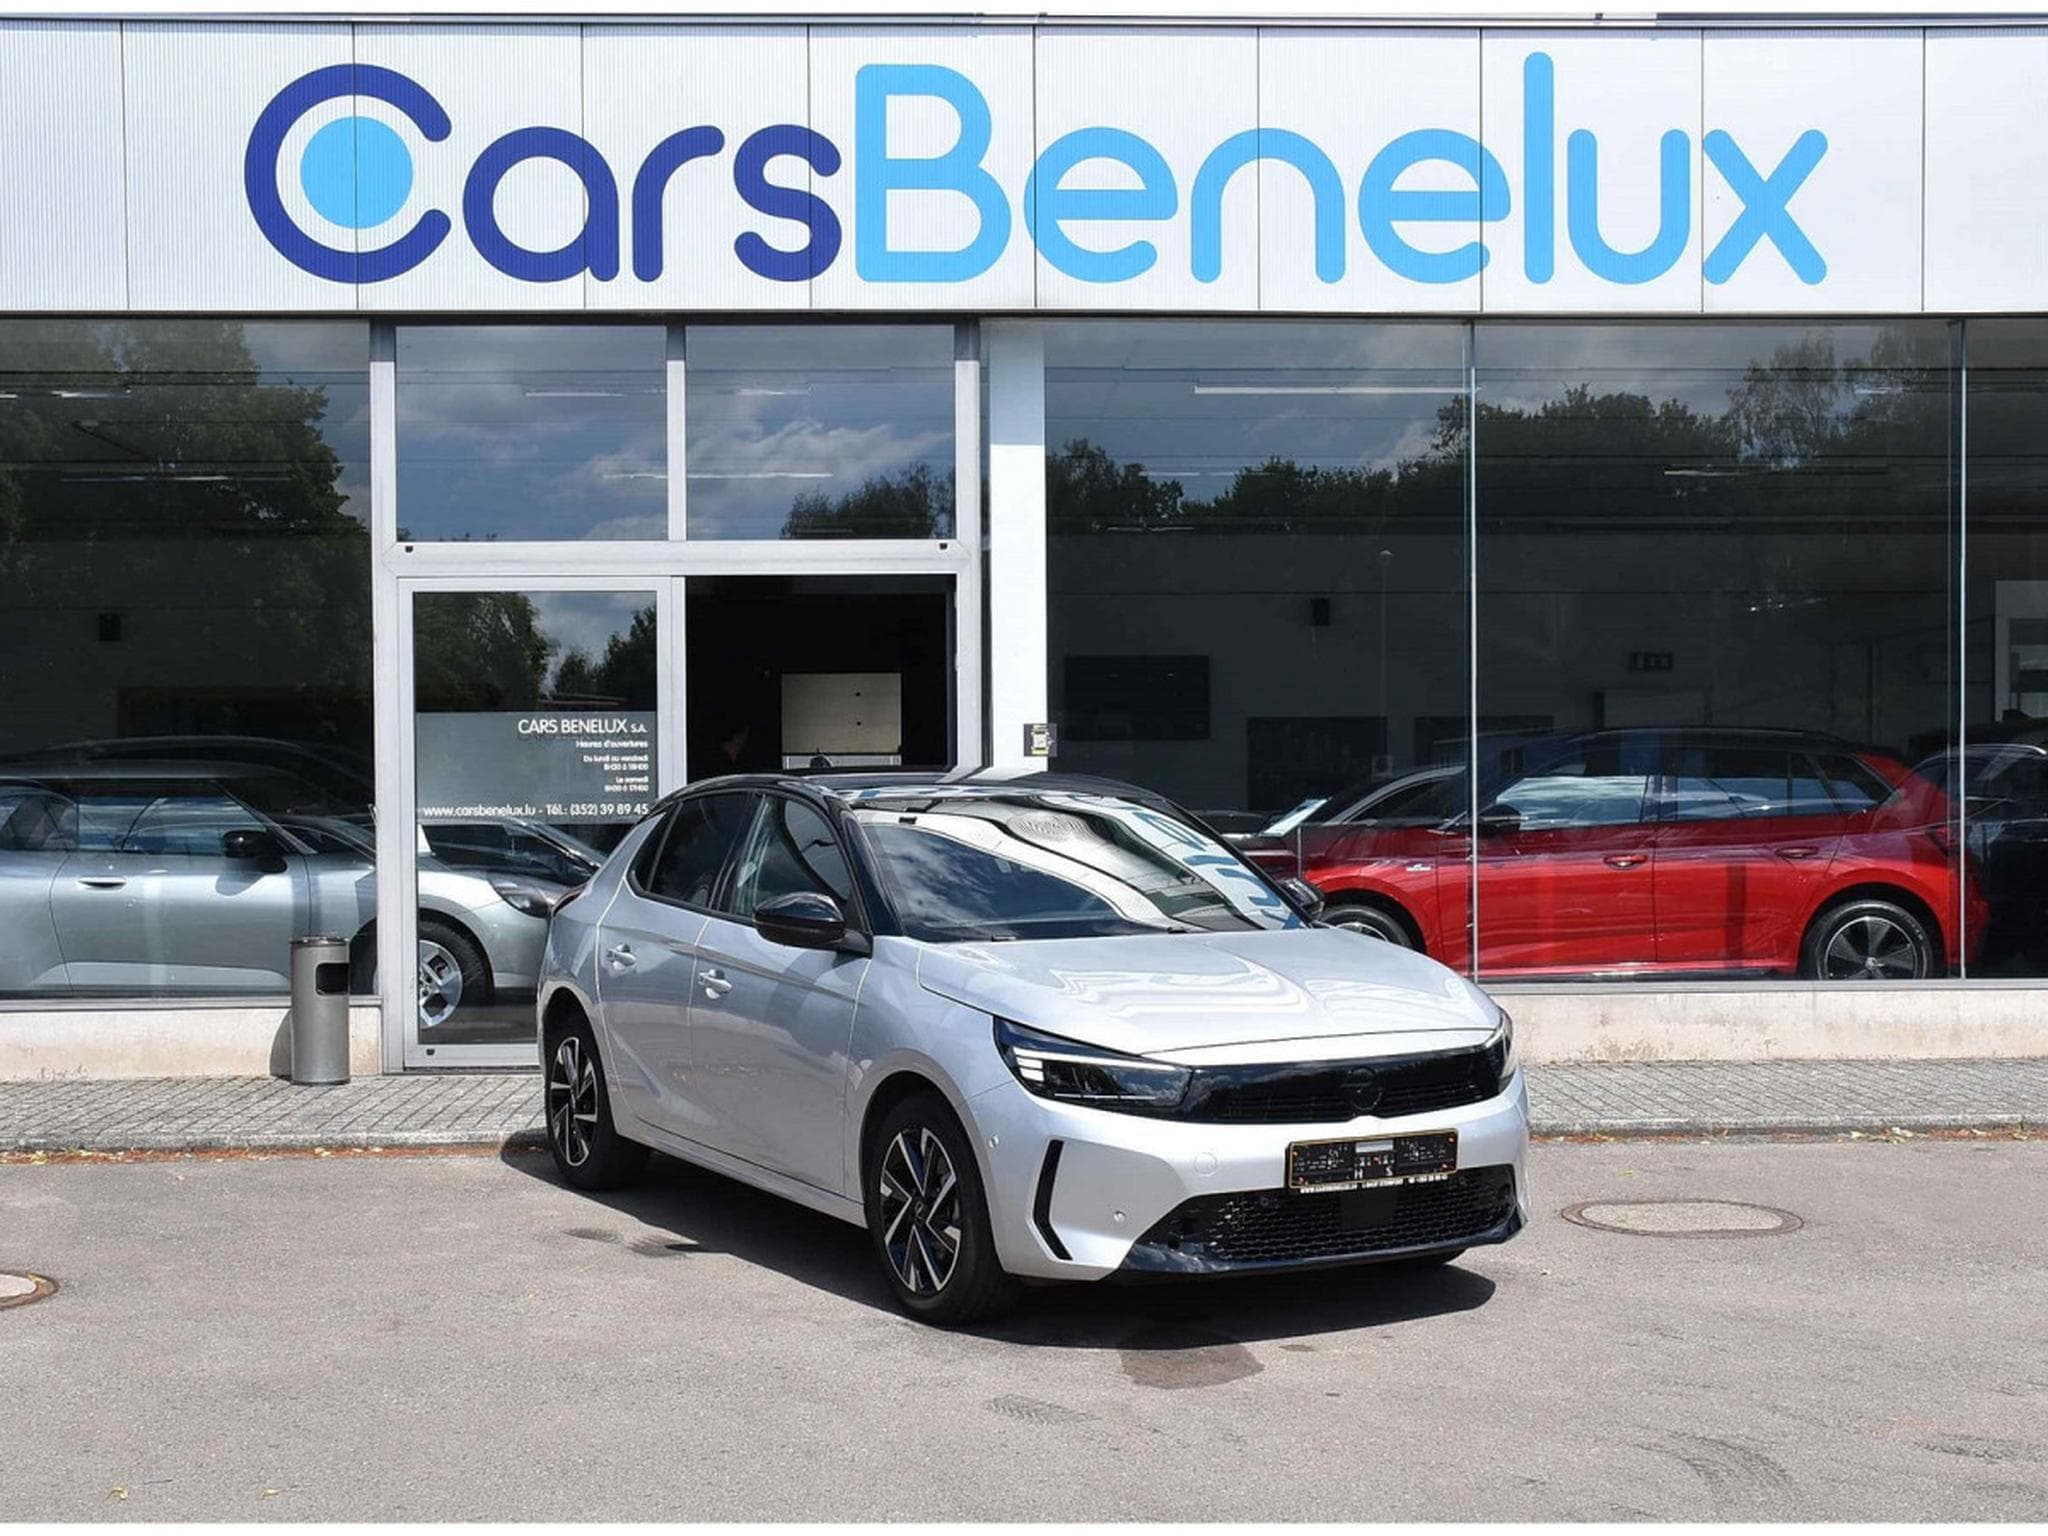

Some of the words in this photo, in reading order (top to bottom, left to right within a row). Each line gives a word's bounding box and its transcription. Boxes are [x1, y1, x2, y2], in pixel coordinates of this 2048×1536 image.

[517, 719, 559, 734] CARS
[560, 718, 628, 734] BENELUX
[423, 804, 536, 817] www.carsbenelux.lu
[570, 803, 598, 817] (352)
[599, 803, 615, 816] 39
[616, 803, 632, 816] 89
[633, 803, 649, 816] 45
